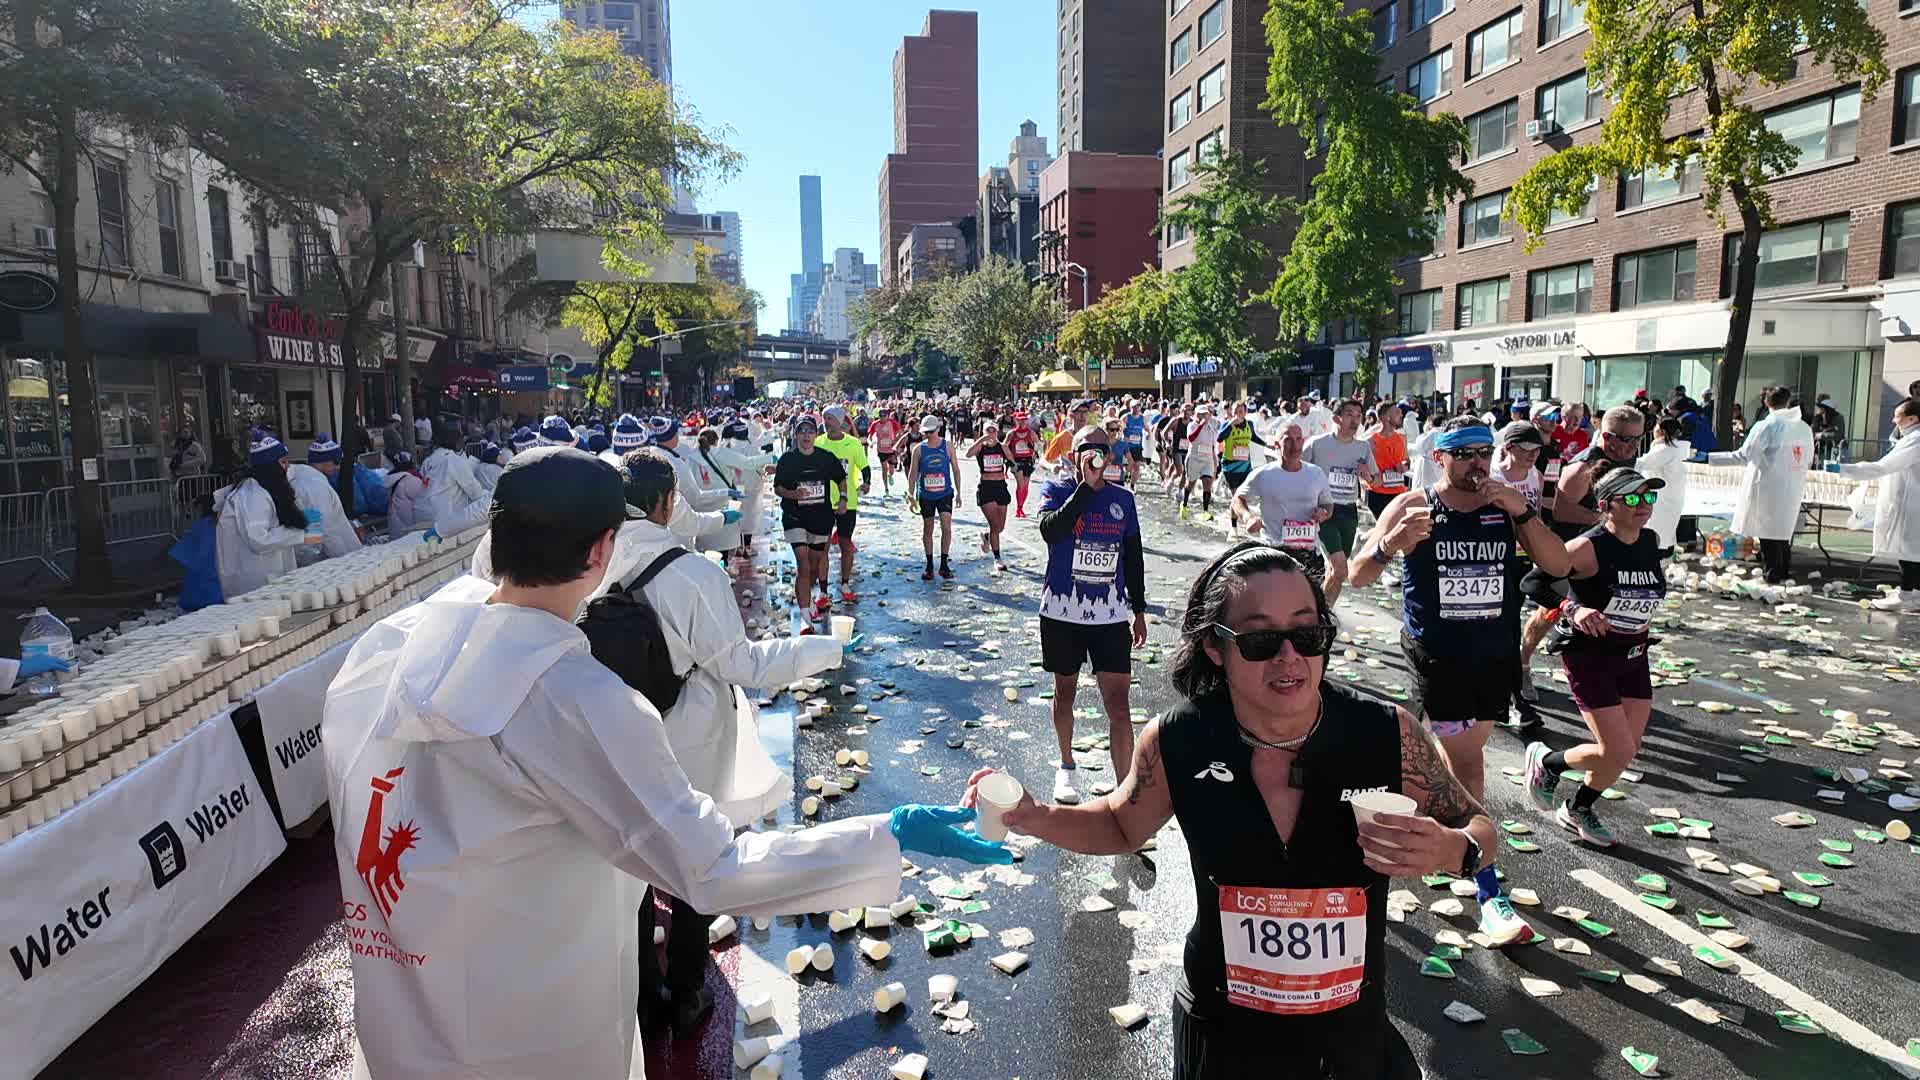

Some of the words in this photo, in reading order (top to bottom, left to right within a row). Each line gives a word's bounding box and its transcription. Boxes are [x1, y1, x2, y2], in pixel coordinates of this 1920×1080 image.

[267, 335, 315, 363] WINE
[318, 341, 330, 364] &
[1503, 333, 1548, 350] SATORI
[1080, 551, 1116, 567] 16657
[1436, 541, 1507, 561] GUSTAVO
[1447, 567, 1463, 577] tcs
[1617, 571, 1659, 585] MARIA
[1444, 578, 1500, 597] 23473
[274, 722, 323, 770] Water
[185, 782, 251, 844] Water
[1237, 890, 1267, 911] tcs
[1269, 900, 1313, 908] CONSULTANCY
[1325, 906, 1349, 914] TATA
[344, 901, 367, 921] cs
[9, 886, 112, 982] Water
[1240, 917, 1347, 960] 18811
[1249, 986, 1257, 996] 2
[1260, 990, 1287, 1000] ORANGE
[1314, 992, 1321, 1000] B
[1331, 983, 1354, 998] 2025
